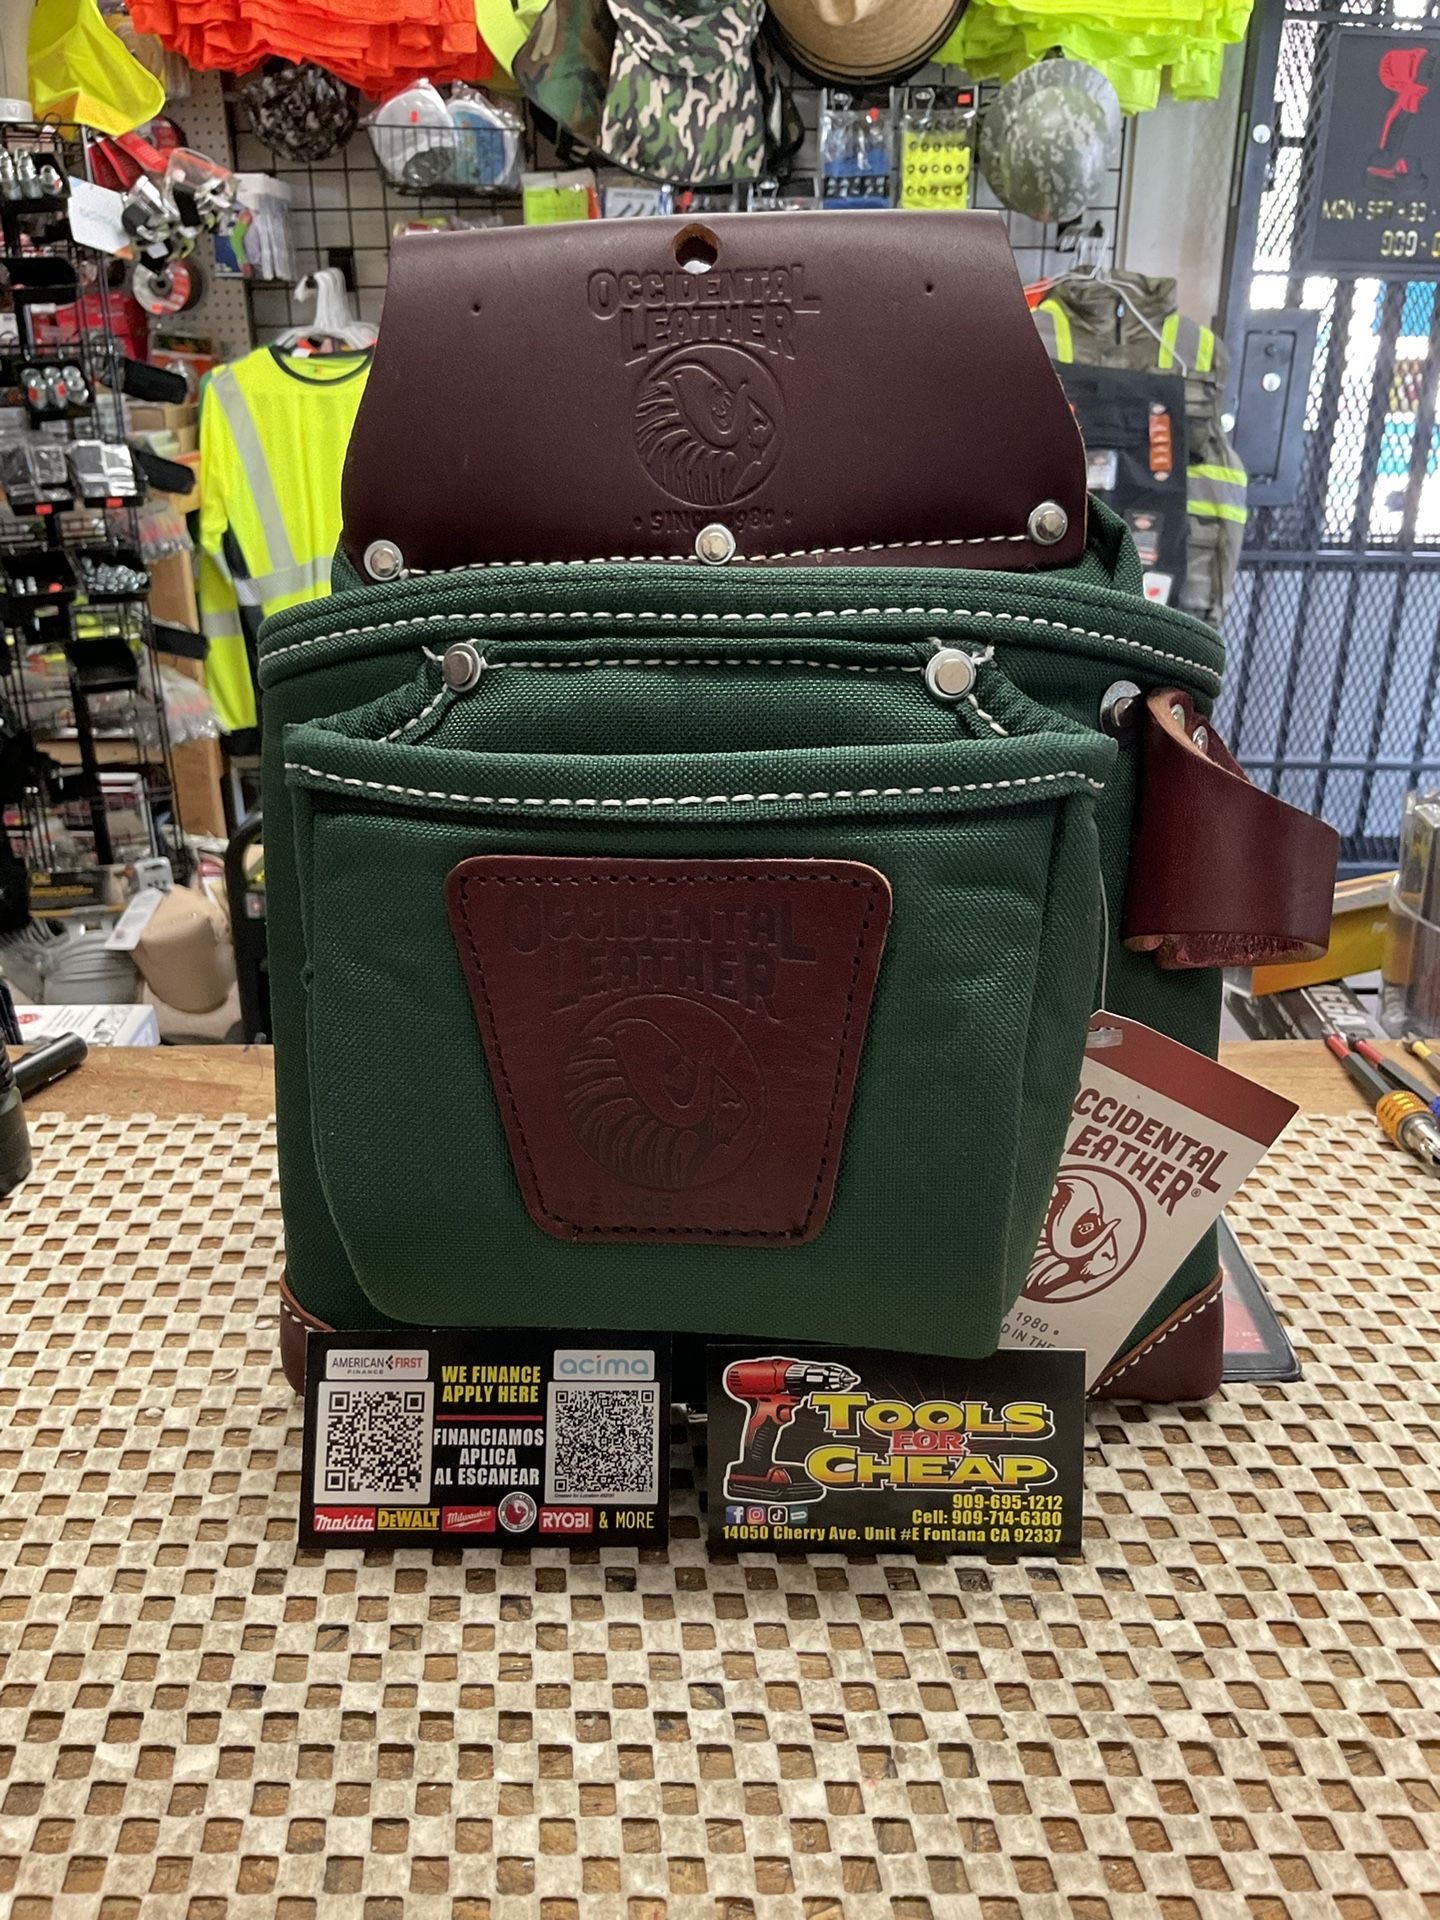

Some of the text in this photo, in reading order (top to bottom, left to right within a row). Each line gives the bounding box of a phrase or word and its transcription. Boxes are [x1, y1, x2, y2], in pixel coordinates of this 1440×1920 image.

[588, 264, 821, 320] OCCIDENTAL
[621, 302, 796, 366] LEATHER
[506, 897, 819, 963] OCCIDENTAL
[550, 944, 784, 1024] LEATHER
[1073, 1088, 1228, 1193] CCIDENTAL
[1066, 1125, 1194, 1216] EATHER
[1016, 1312, 1049, 1332] 1980
[1011, 1328, 1028, 1342] IN
[332, 1357, 423, 1368] AMERICAN FIRST
[559, 1355, 649, 1375] acima
[441, 1366, 541, 1383] WE FINANCE
[442, 1386, 539, 1403] APPLY HERE
[810, 1393, 1046, 1434] TOOLS
[433, 1429, 544, 1446] FINANCIAMOS
[892, 1431, 963, 1451] FOR
[459, 1449, 517, 1466] APLICA
[807, 1447, 1048, 1485] CHEAP
[434, 1468, 540, 1486] AL ESCANEAR
[953, 1494, 1063, 1510] 909-695-1212
[542, 1512, 589, 1528] RYOBI
[599, 1511, 655, 1529] & MORE
[912, 1509, 1063, 1526] Cell: 909-714-6380
[723, 1525, 1062, 1543] 14050 Cherry Ave. Unit #E Fontana CA 92337
